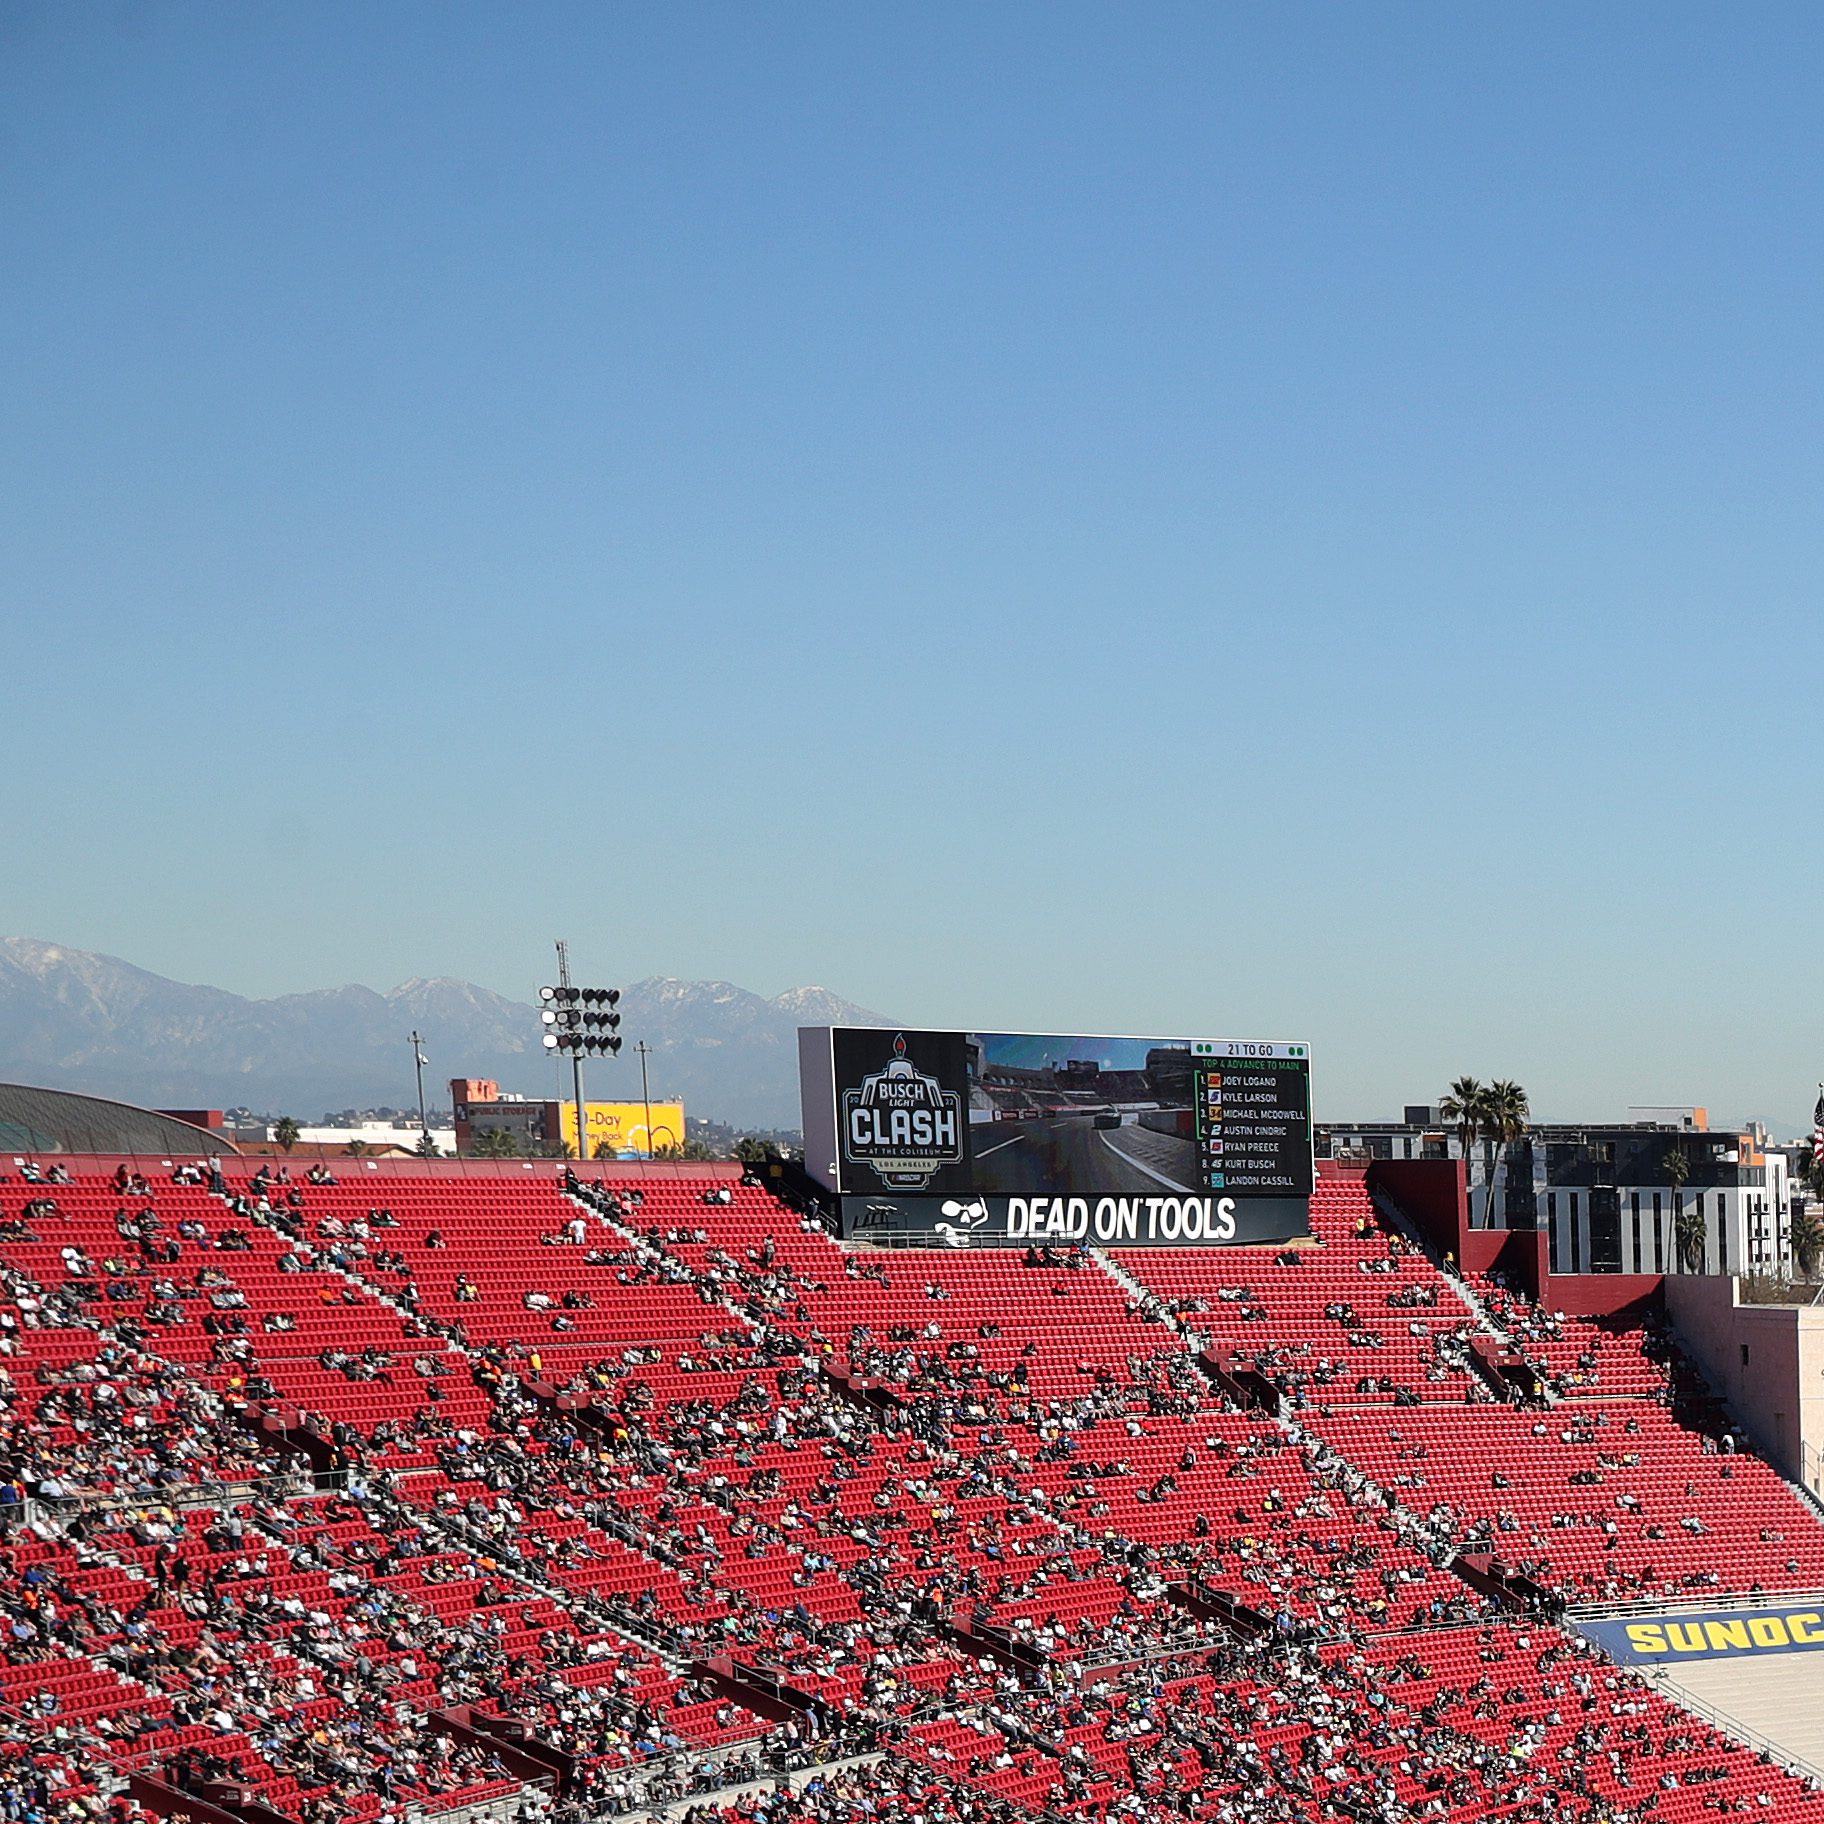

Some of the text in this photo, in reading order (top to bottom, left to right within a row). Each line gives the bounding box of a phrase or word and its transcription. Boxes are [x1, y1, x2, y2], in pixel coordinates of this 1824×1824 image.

[1228, 1044, 1273, 1056] 21 TO GO
[879, 1083, 924, 1100] BUSCH
[889, 1099, 915, 1107] LIGHT
[1261, 1110, 1306, 1120] MCDOWELL
[851, 1108, 955, 1145] CLASH
[1007, 1197, 1236, 1241] DEAD ON TOOLS
